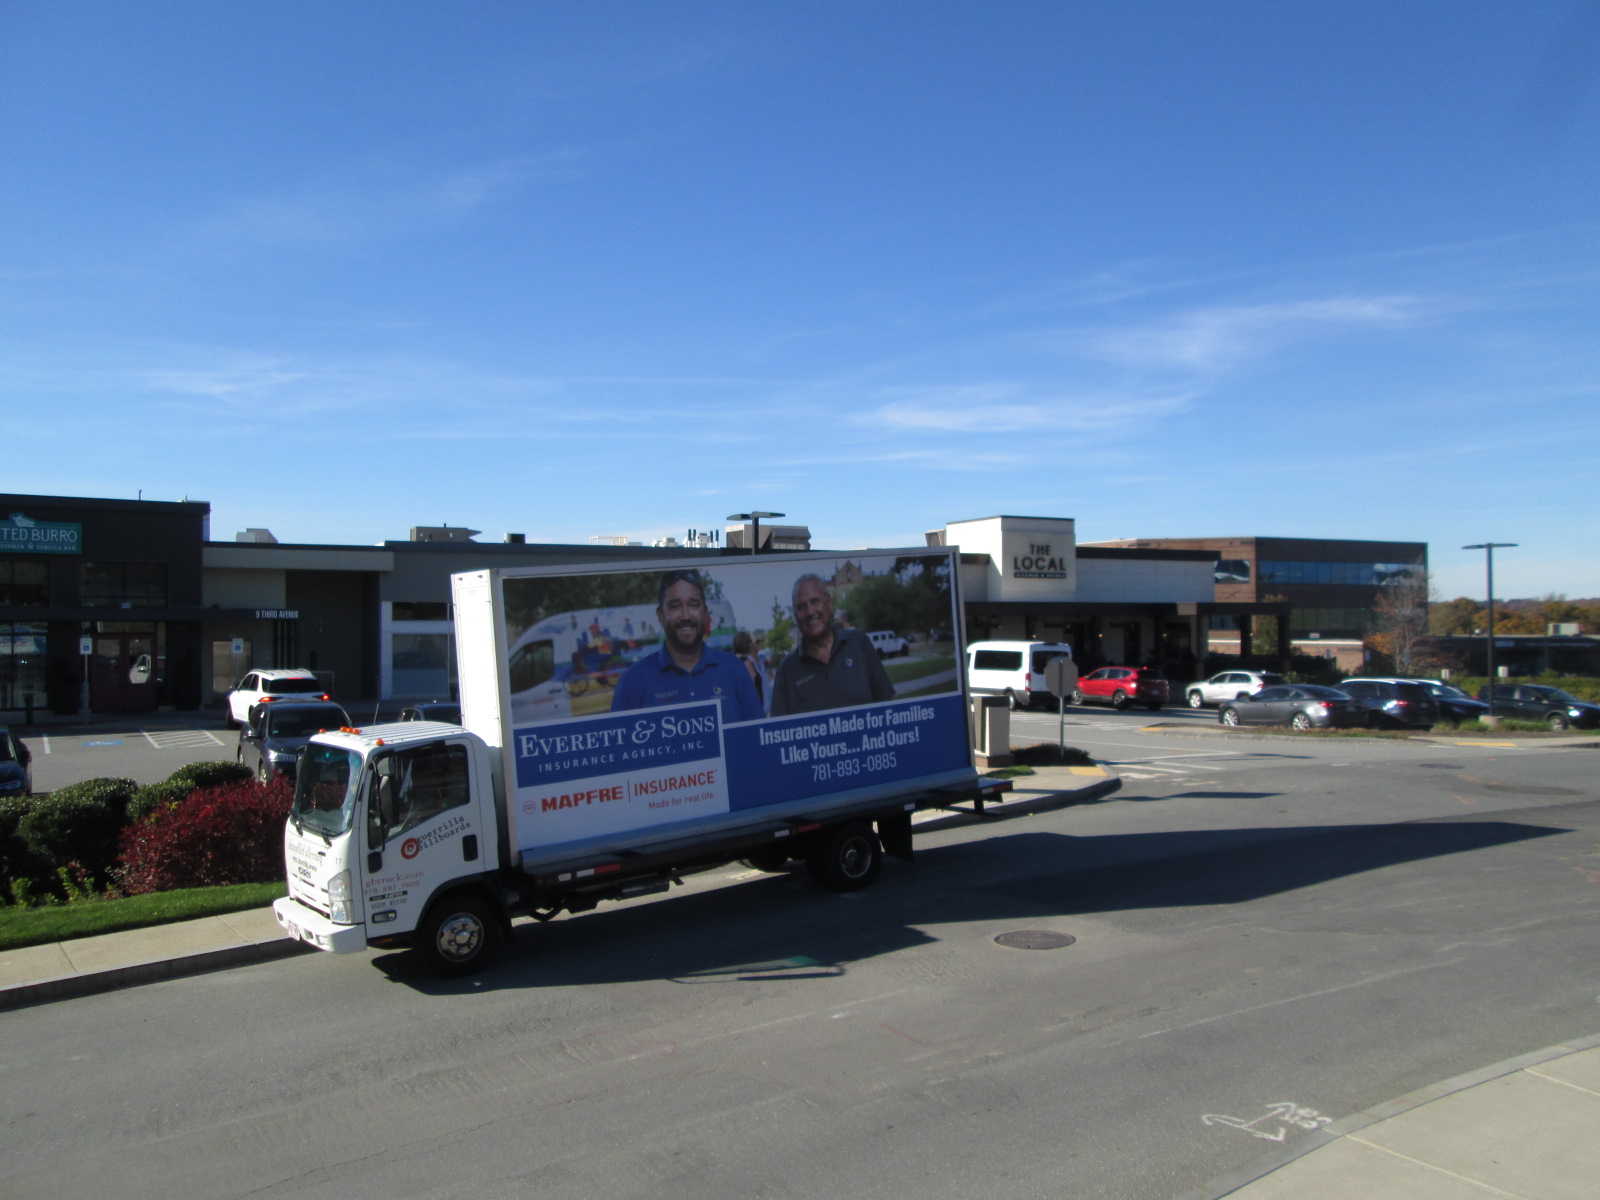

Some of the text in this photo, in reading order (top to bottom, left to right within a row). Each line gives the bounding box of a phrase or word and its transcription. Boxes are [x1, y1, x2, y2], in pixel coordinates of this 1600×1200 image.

[31, 528, 78, 542] BURRO
[1029, 544, 1051, 556] THE
[1013, 556, 1066, 571] LOCAL
[255, 610, 299, 619] 9 THIRD AVENUE
[518, 716, 715, 758] EVERETT & SONS
[759, 705, 935, 745] Insurance Made for Families
[539, 740, 704, 773] INSURANCE AGENCY, INC.
[780, 726, 920, 765] Like Yours... And Ours!
[811, 751, 897, 782] 781-893-0885
[541, 770, 715, 812] MAPFRE INSURANCE
[648, 791, 716, 809] Made for real life.
[416, 815, 465, 845] guerrilla
[365, 871, 424, 888] gbtruck.com
